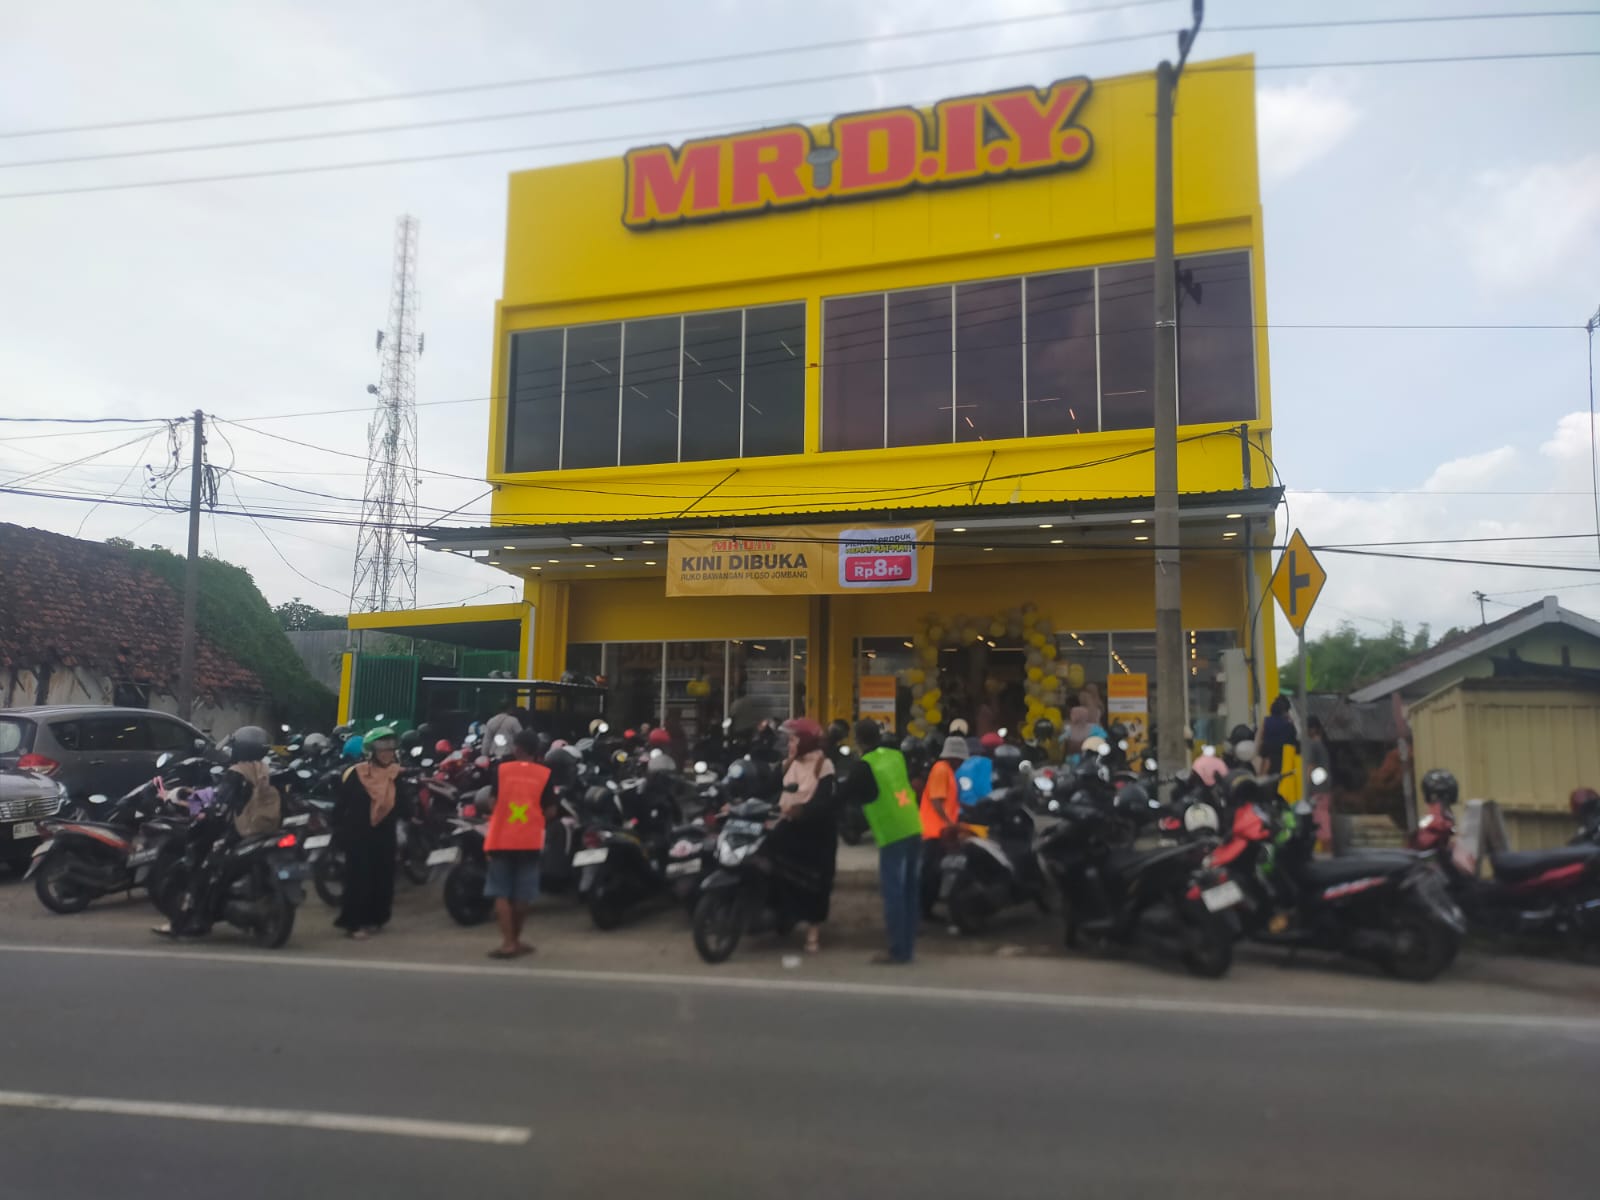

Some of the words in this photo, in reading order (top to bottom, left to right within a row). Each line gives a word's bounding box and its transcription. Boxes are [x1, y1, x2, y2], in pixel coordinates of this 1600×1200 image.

[627, 82, 1087, 222] MRD.I.Y.
[681, 555, 722, 572] KINI
[728, 553, 808, 571] DIBUKA
[746, 571, 770, 580] PLOSO
[771, 570, 808, 579] JOMBANG
